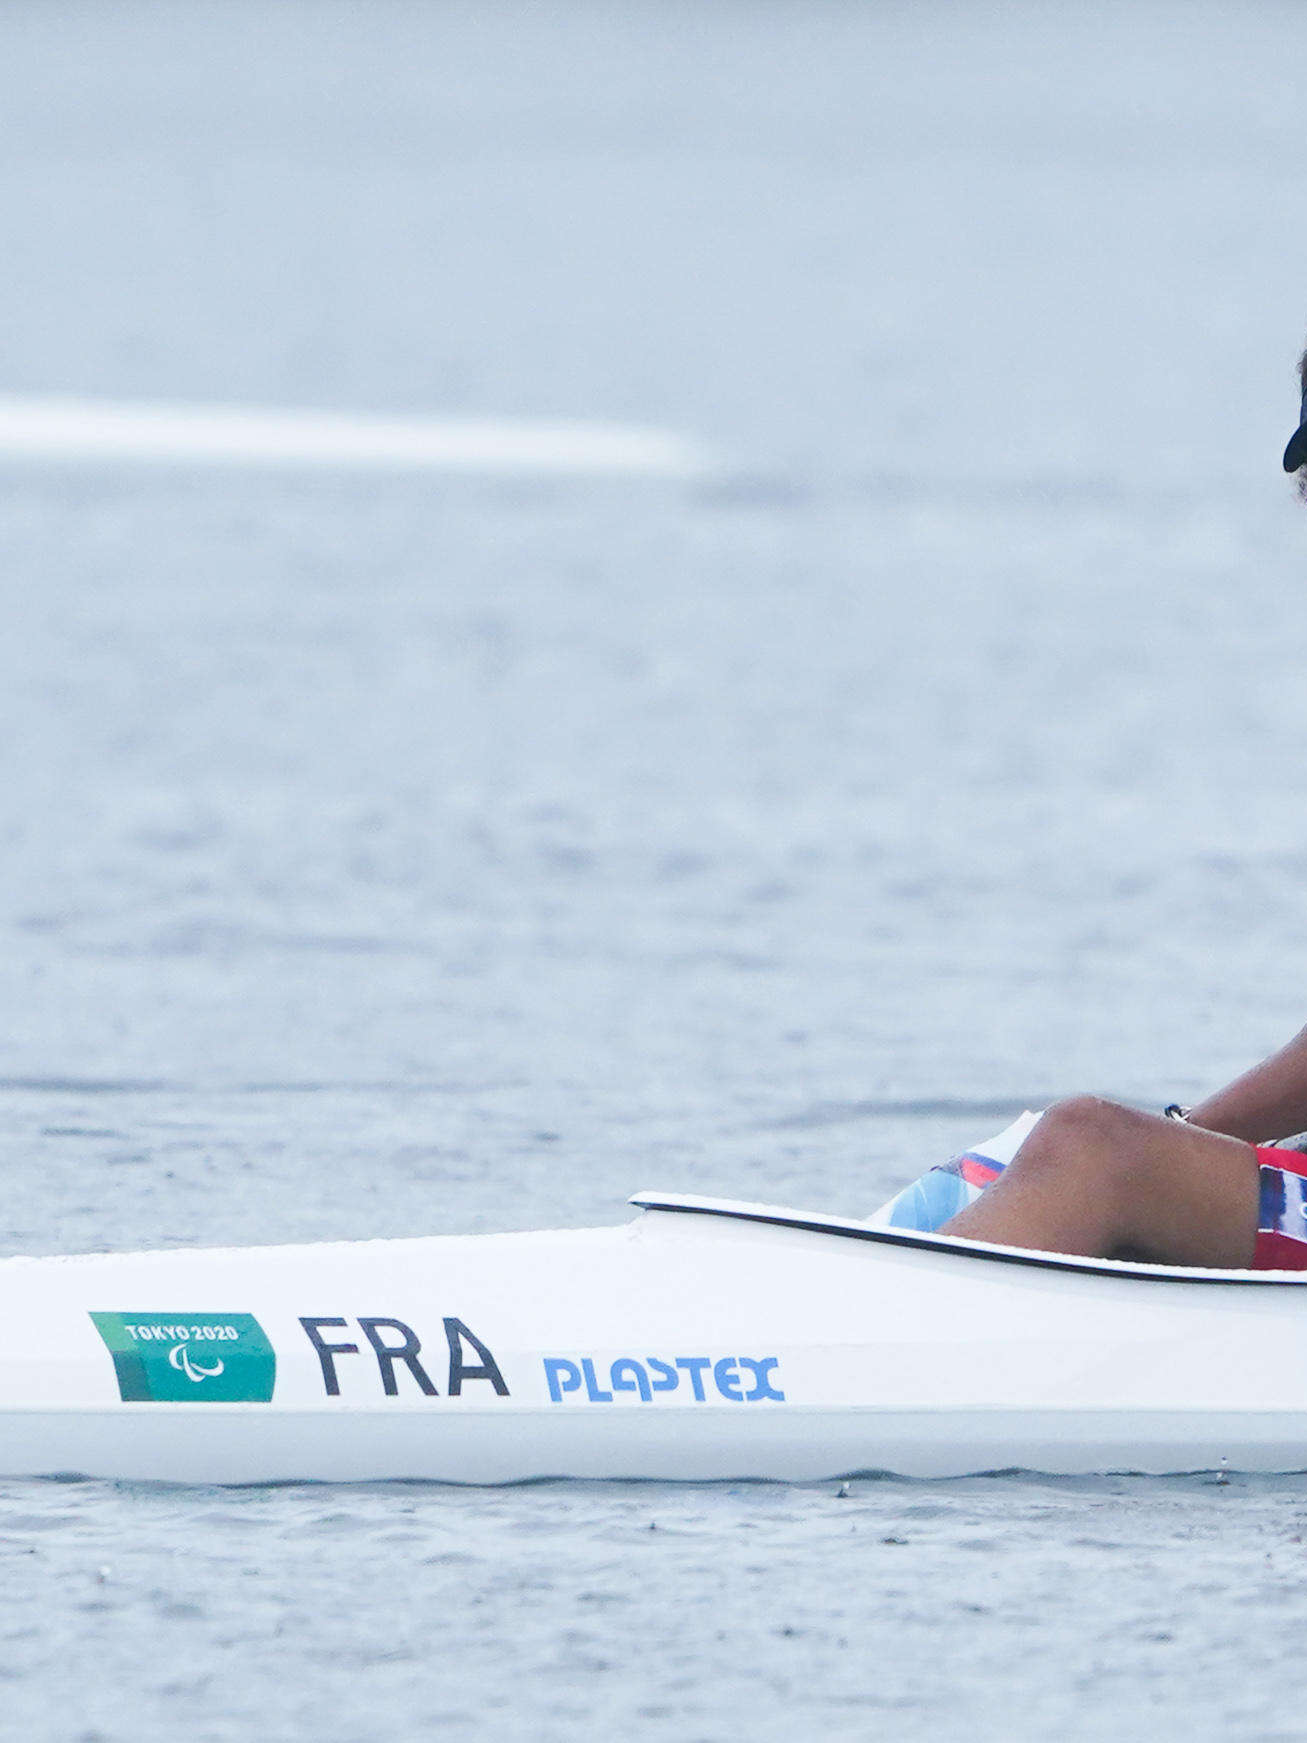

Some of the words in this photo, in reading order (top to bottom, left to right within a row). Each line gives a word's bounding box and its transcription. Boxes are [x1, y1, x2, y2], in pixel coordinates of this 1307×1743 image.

[124, 1325, 190, 1341] TOKYO
[190, 1325, 239, 1341] 2020
[298, 1317, 510, 1396] FRA
[543, 1357, 786, 1402] PLASTEX
